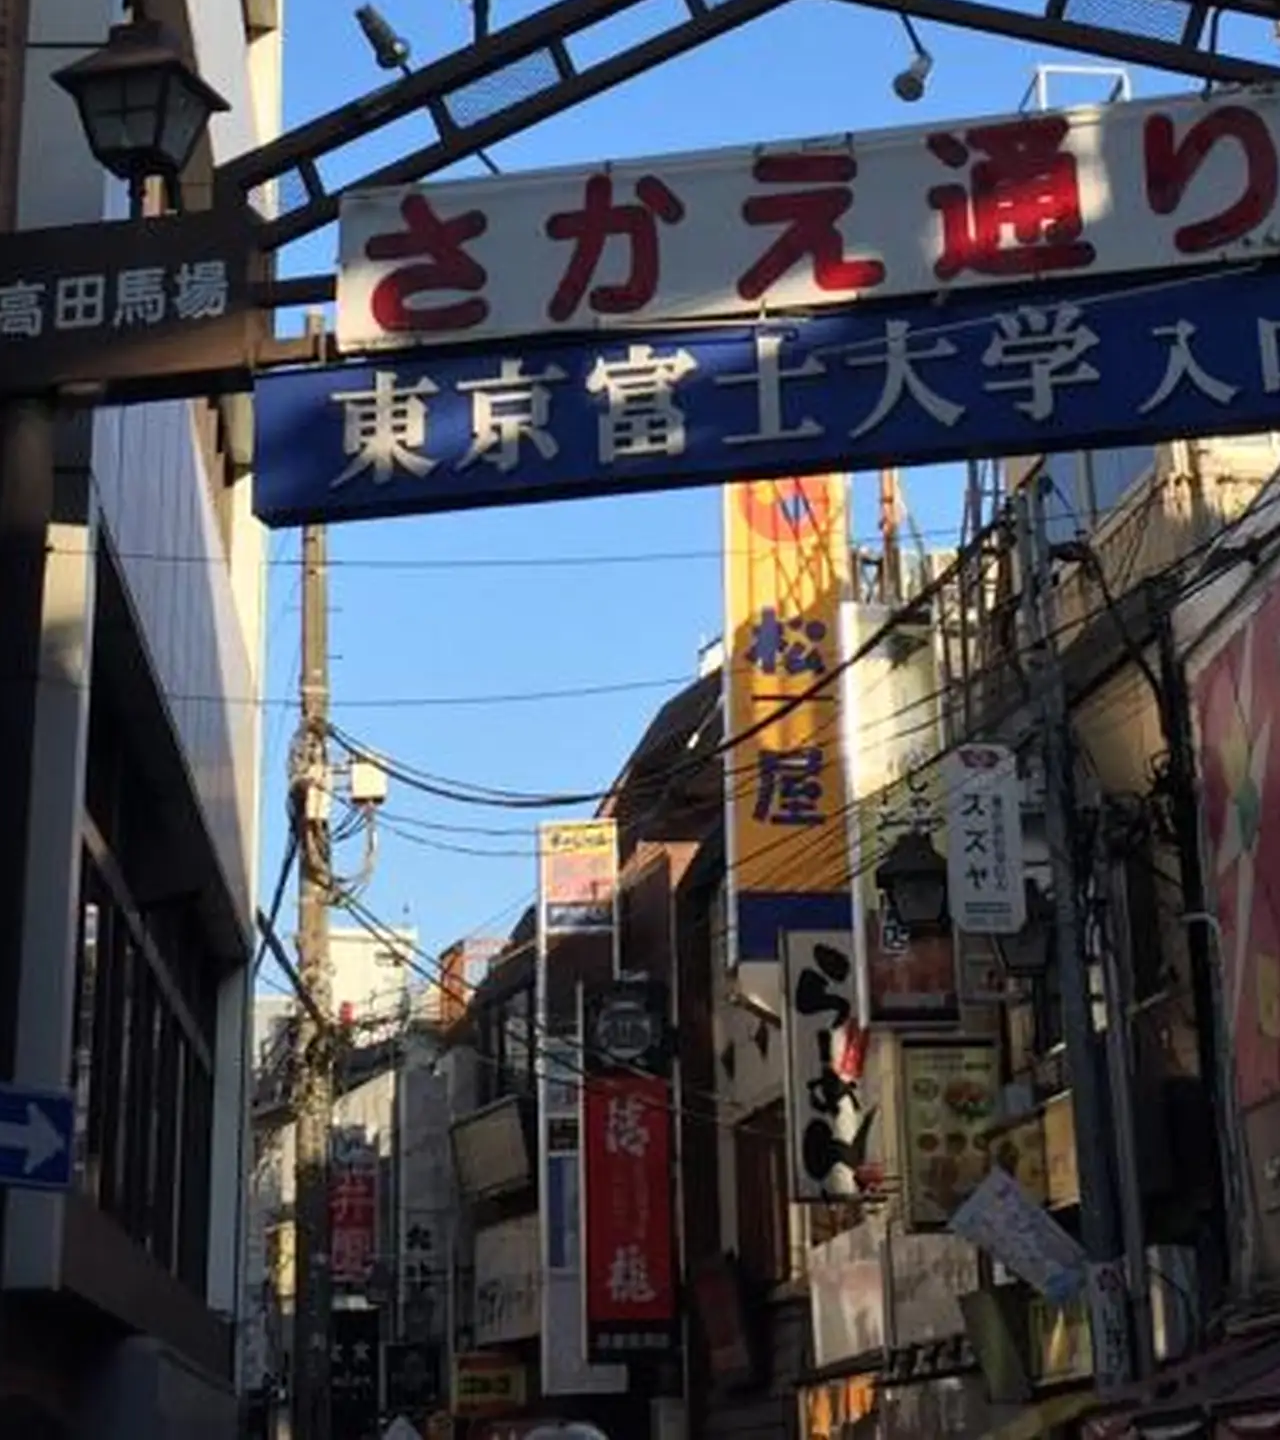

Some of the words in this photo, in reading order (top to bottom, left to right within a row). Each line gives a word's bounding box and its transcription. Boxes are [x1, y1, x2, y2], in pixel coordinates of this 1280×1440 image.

[365, 105, 1278, 333] さかえ通り
[329, 302, 1101, 487] 東京富士大学
